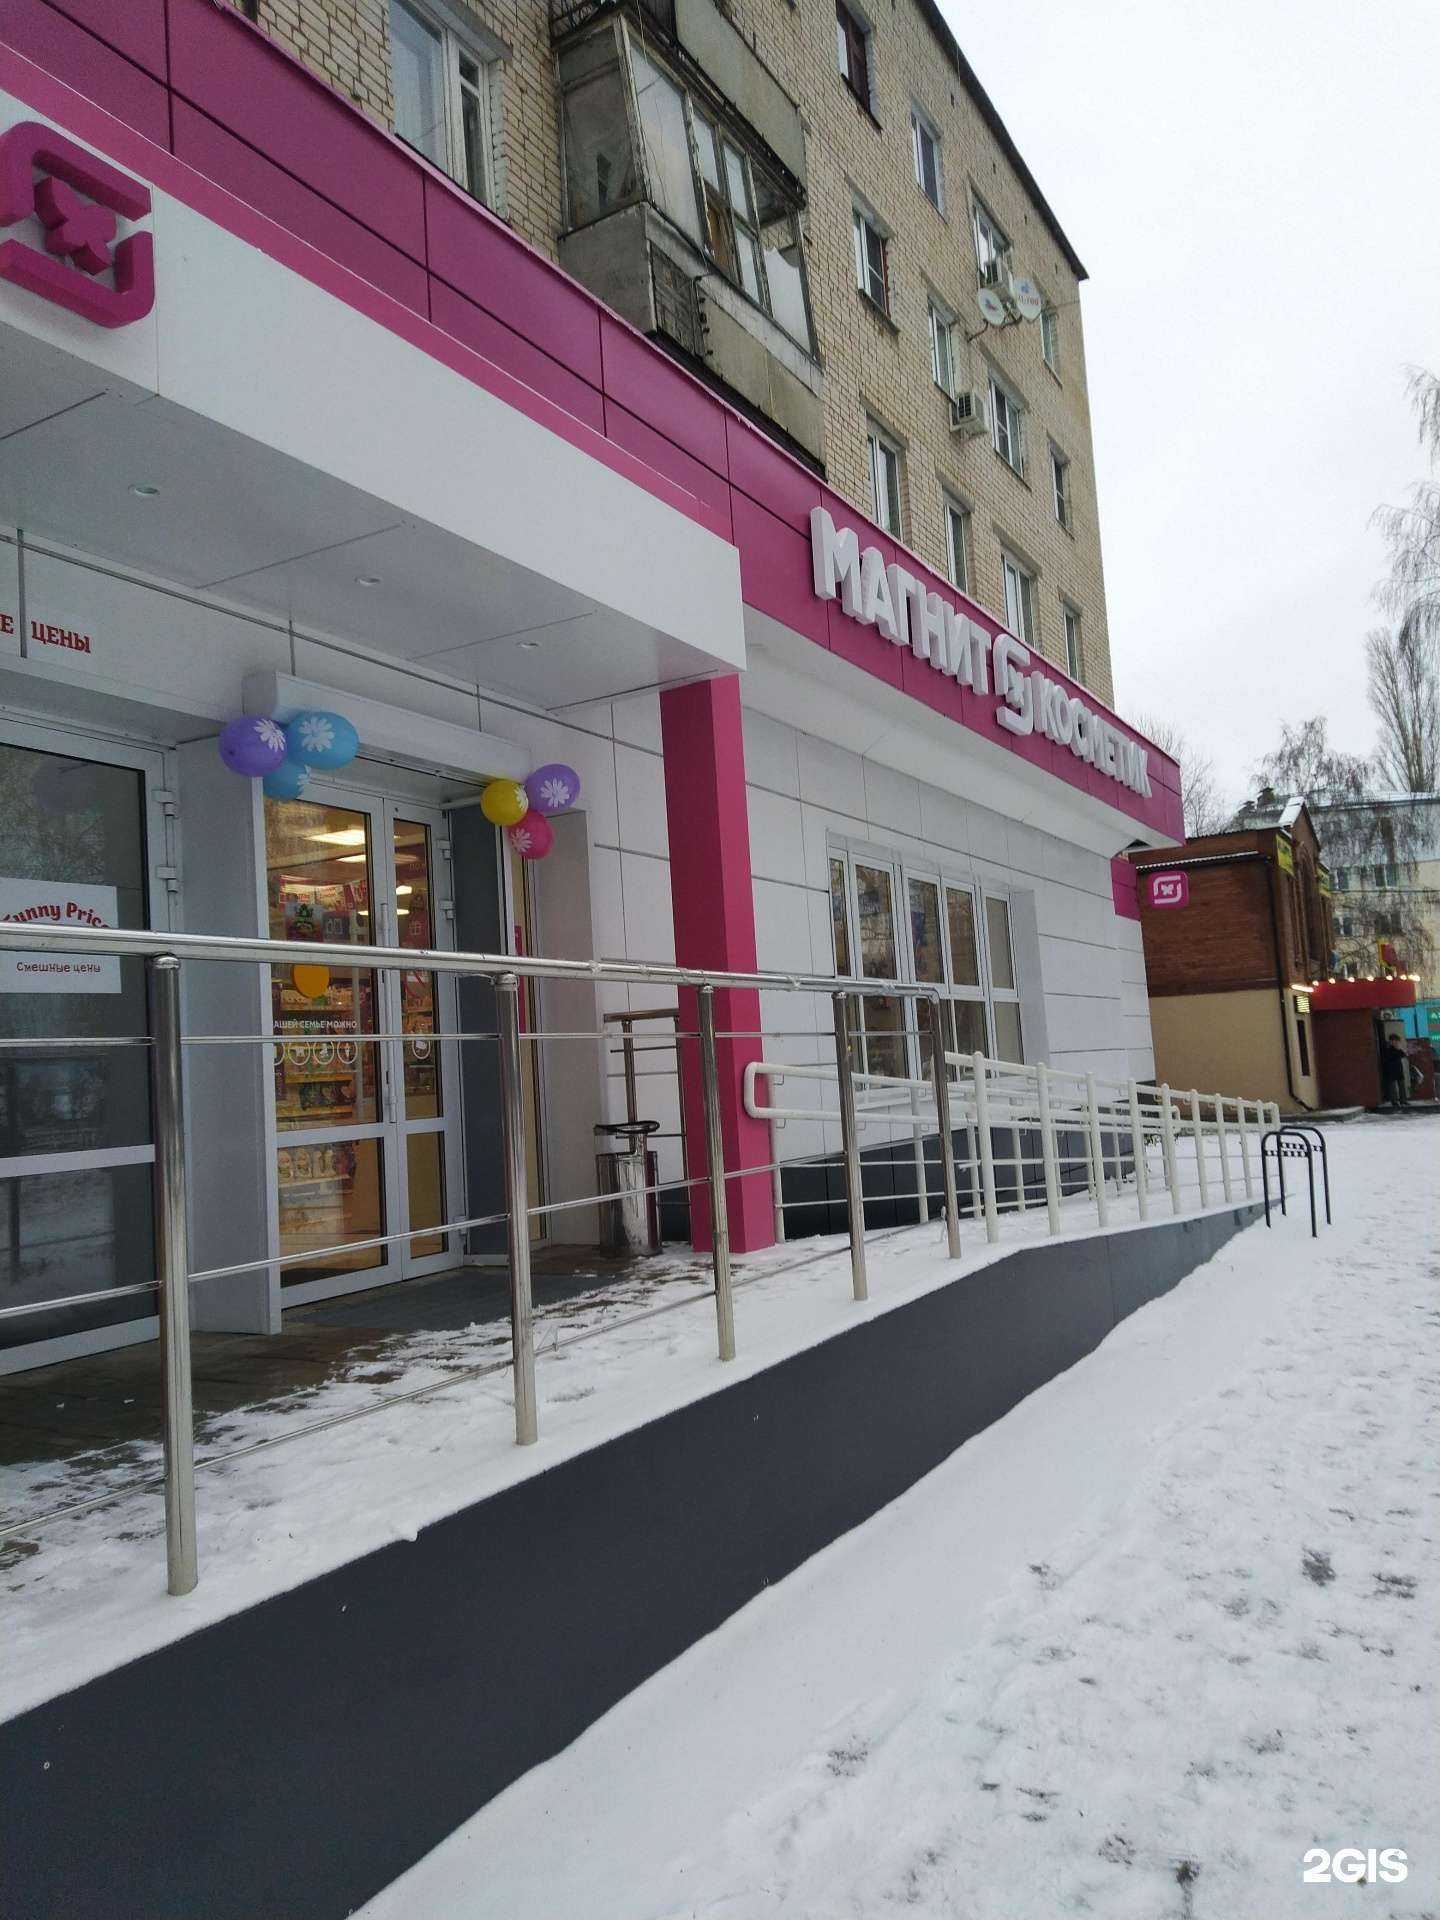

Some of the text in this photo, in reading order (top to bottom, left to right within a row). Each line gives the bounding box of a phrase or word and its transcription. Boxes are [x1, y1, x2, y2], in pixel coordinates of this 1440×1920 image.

[31, 621, 91, 653] ЦЕНЫ
[810, 506, 1152, 798] МАГНИТ КОСМЕТИК
[66, 902, 110, 928] Pric
[16, 962, 101, 973] Смешные цены
[273, 1018, 298, 1029] АШЕЙ
[326, 1020, 358, 1029] МОЖНО
